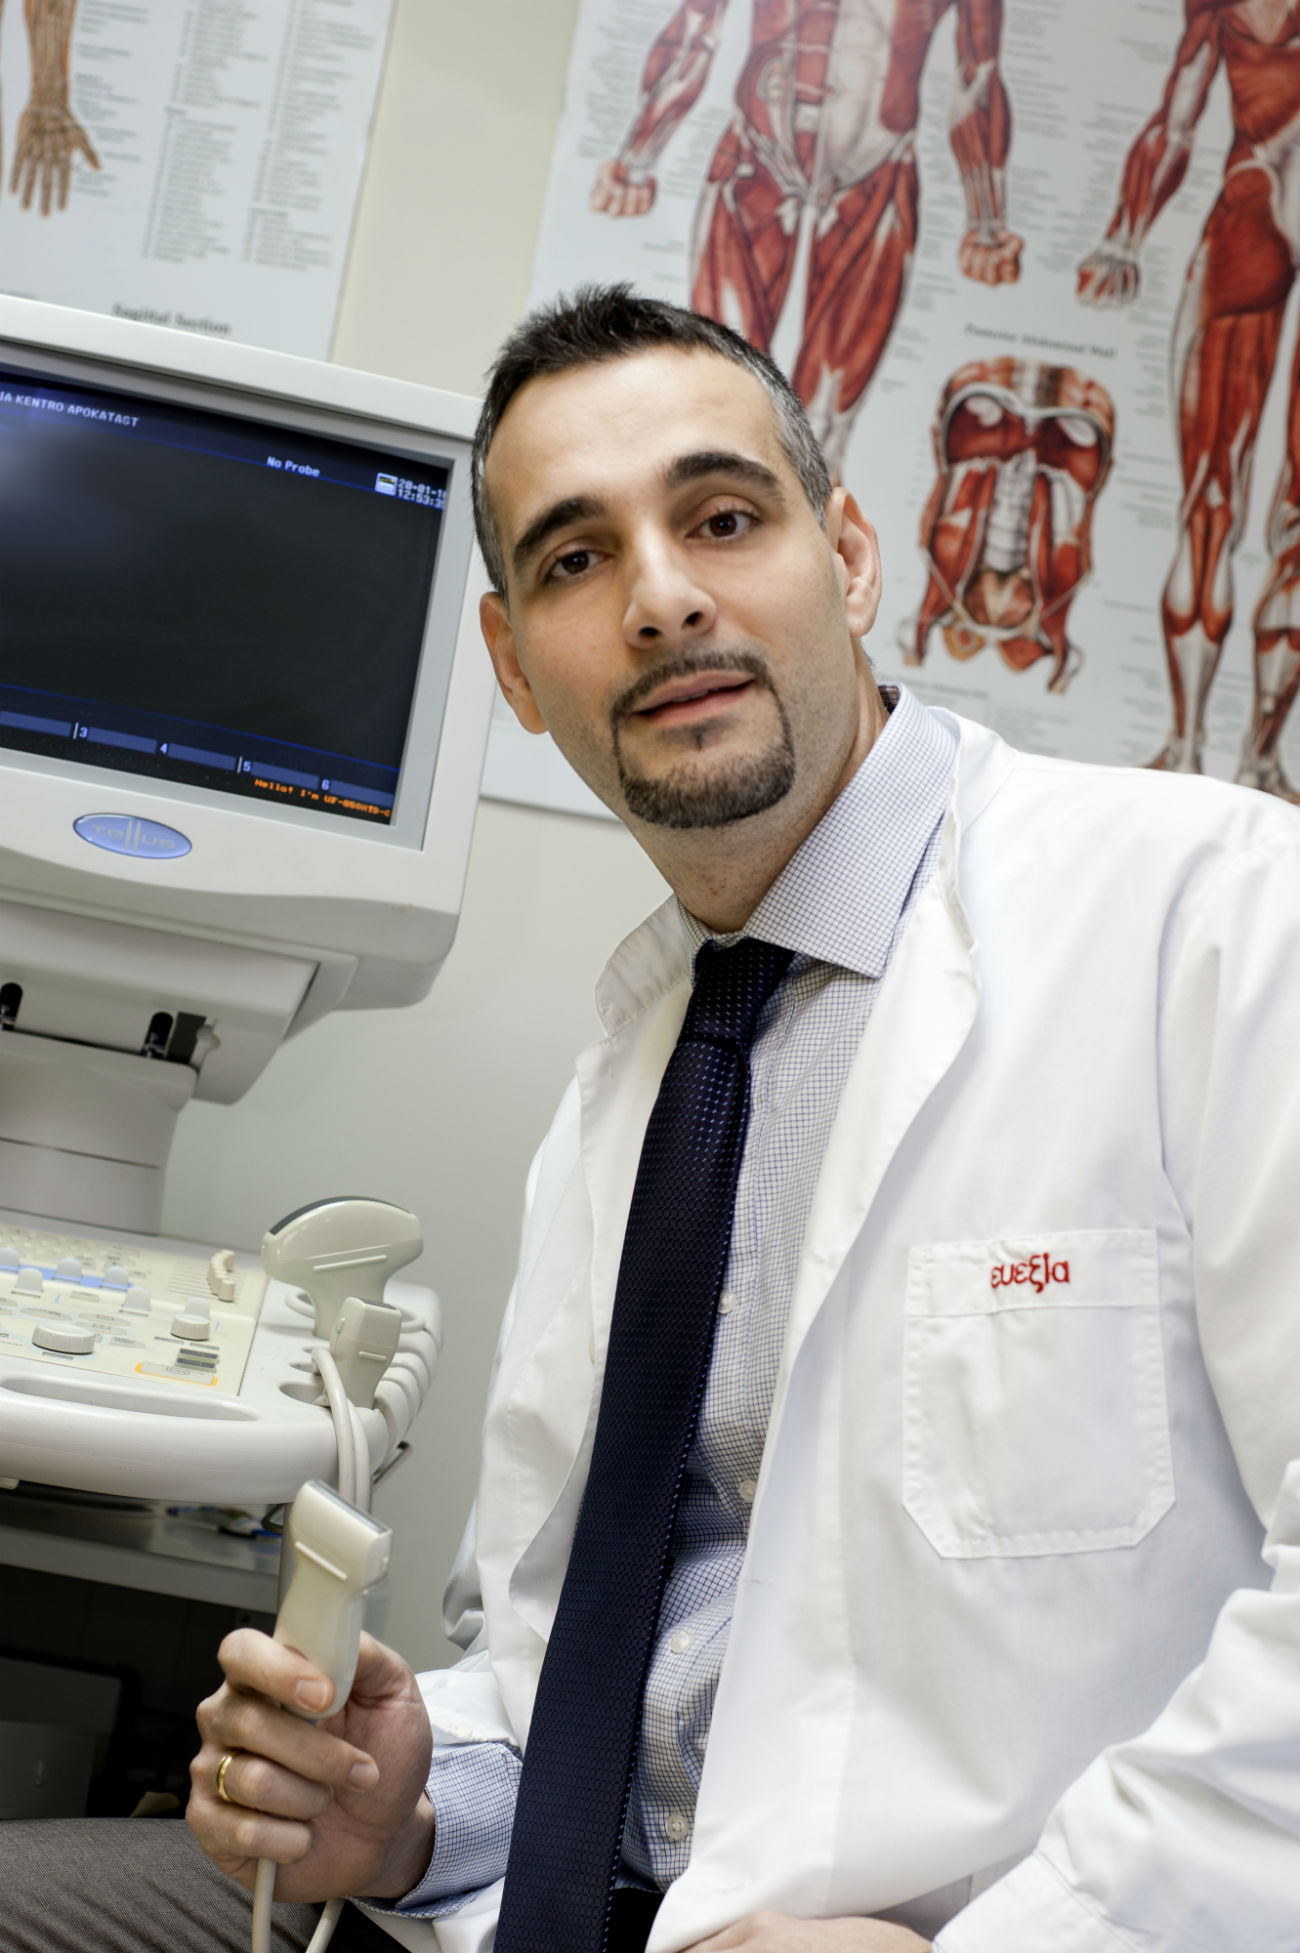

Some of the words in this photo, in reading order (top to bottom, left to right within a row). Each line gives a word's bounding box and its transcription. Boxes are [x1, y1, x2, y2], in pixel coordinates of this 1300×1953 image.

[15, 394, 64, 412] KENTRO
[267, 456, 282, 469] No
[285, 460, 320, 477] Probe
[79, 726, 89, 738] 3
[159, 743, 168, 754] 4
[243, 761, 251, 772] 5
[321, 779, 330, 791] 6
